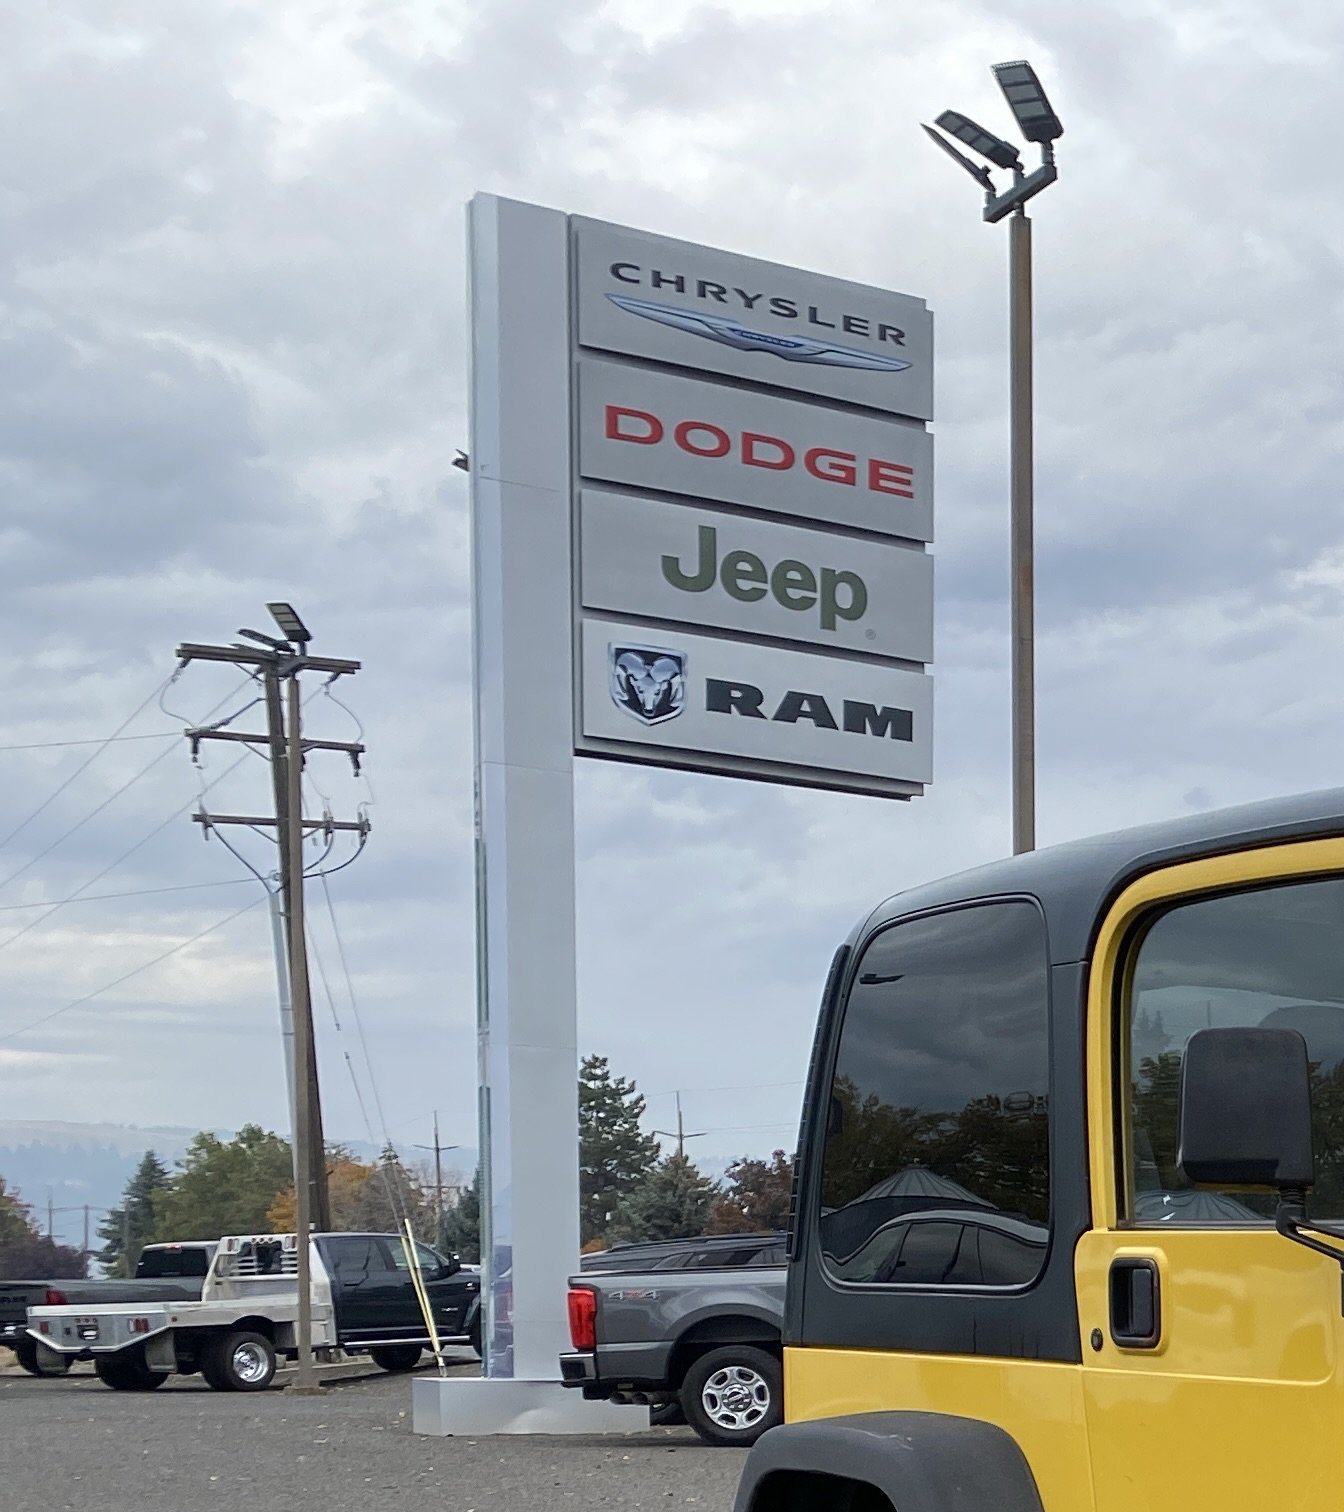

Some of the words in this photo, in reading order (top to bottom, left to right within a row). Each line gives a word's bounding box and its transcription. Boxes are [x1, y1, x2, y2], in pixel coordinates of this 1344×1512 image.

[609, 262, 907, 347] CHRYSLER
[605, 404, 915, 499] DODGE
[661, 524, 868, 632] Jeep
[705, 677, 914, 743] RAM
